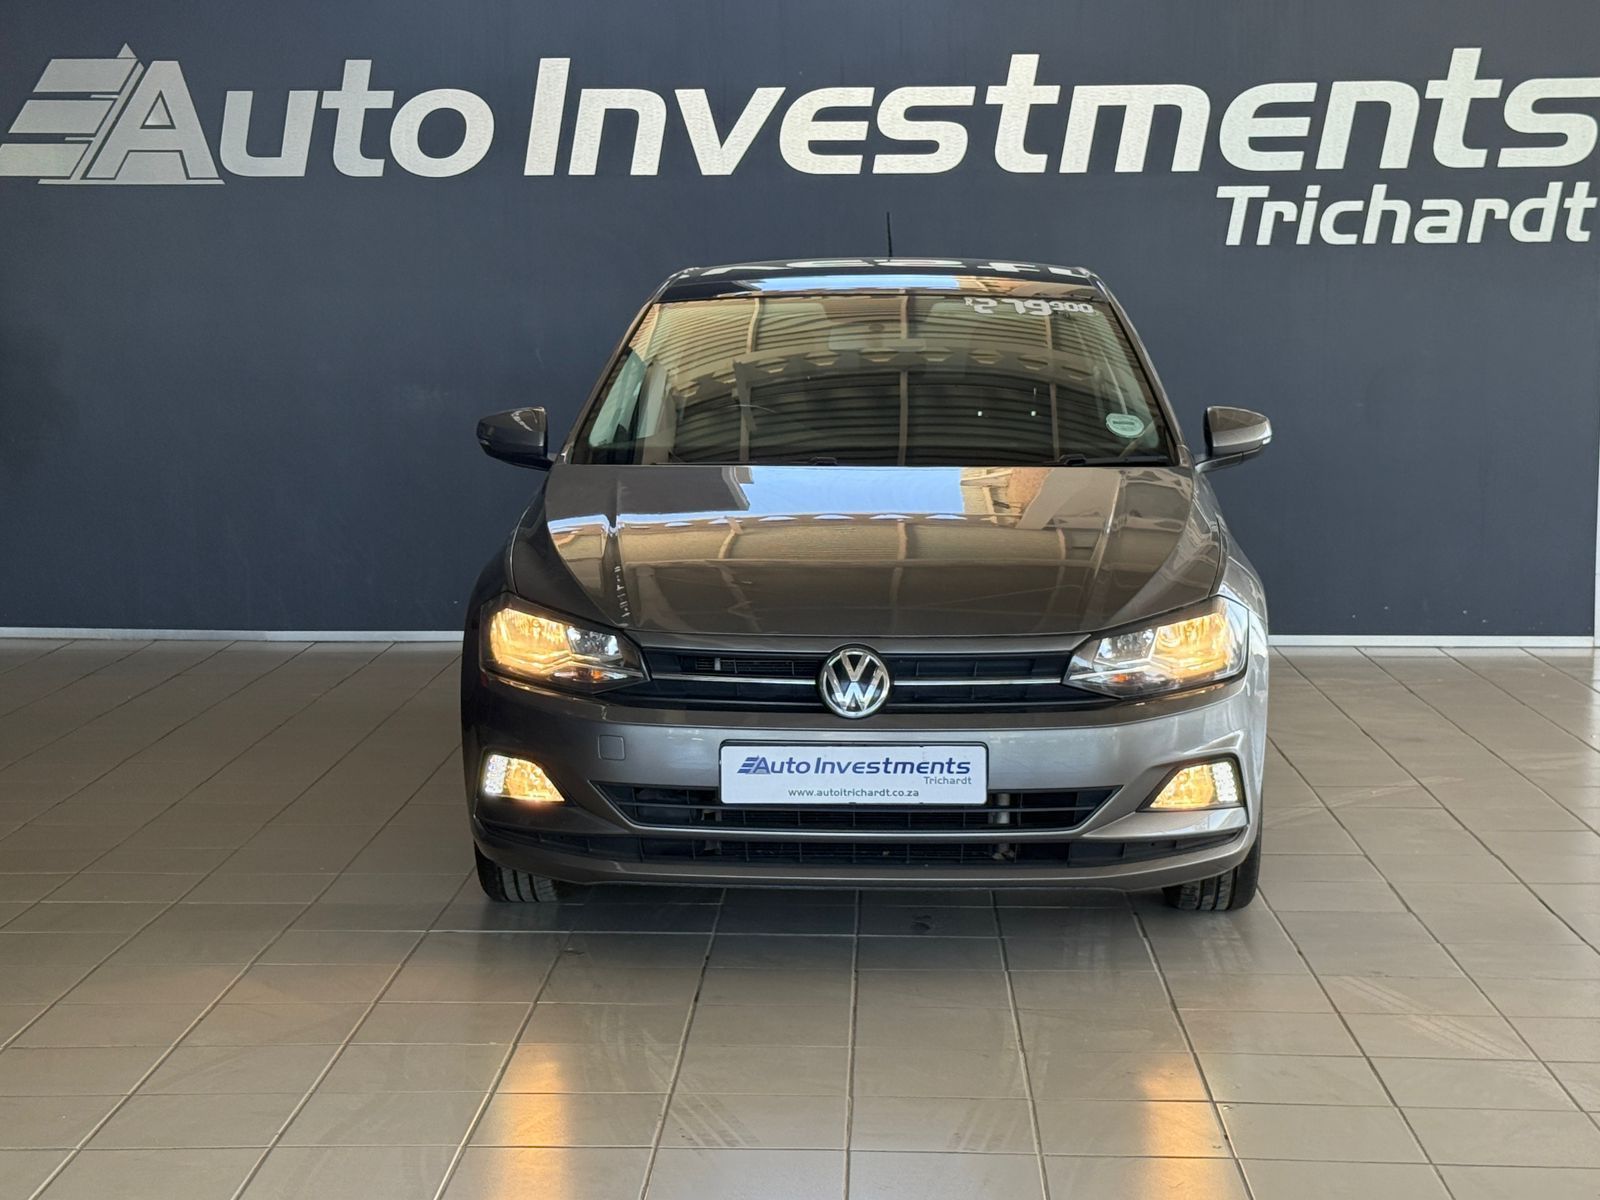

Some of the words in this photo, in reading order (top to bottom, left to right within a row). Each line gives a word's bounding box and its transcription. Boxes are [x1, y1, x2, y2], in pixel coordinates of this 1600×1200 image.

[84, 58, 495, 179] Auto
[522, 47, 1600, 177] Investments
[1216, 181, 1598, 247] Trichardt
[752, 757, 810, 775] Auto
[814, 757, 971, 775] Investments
[924, 776, 972, 786] Trichardt
[788, 788, 920, 799] www.autoitrichardt.co.za
